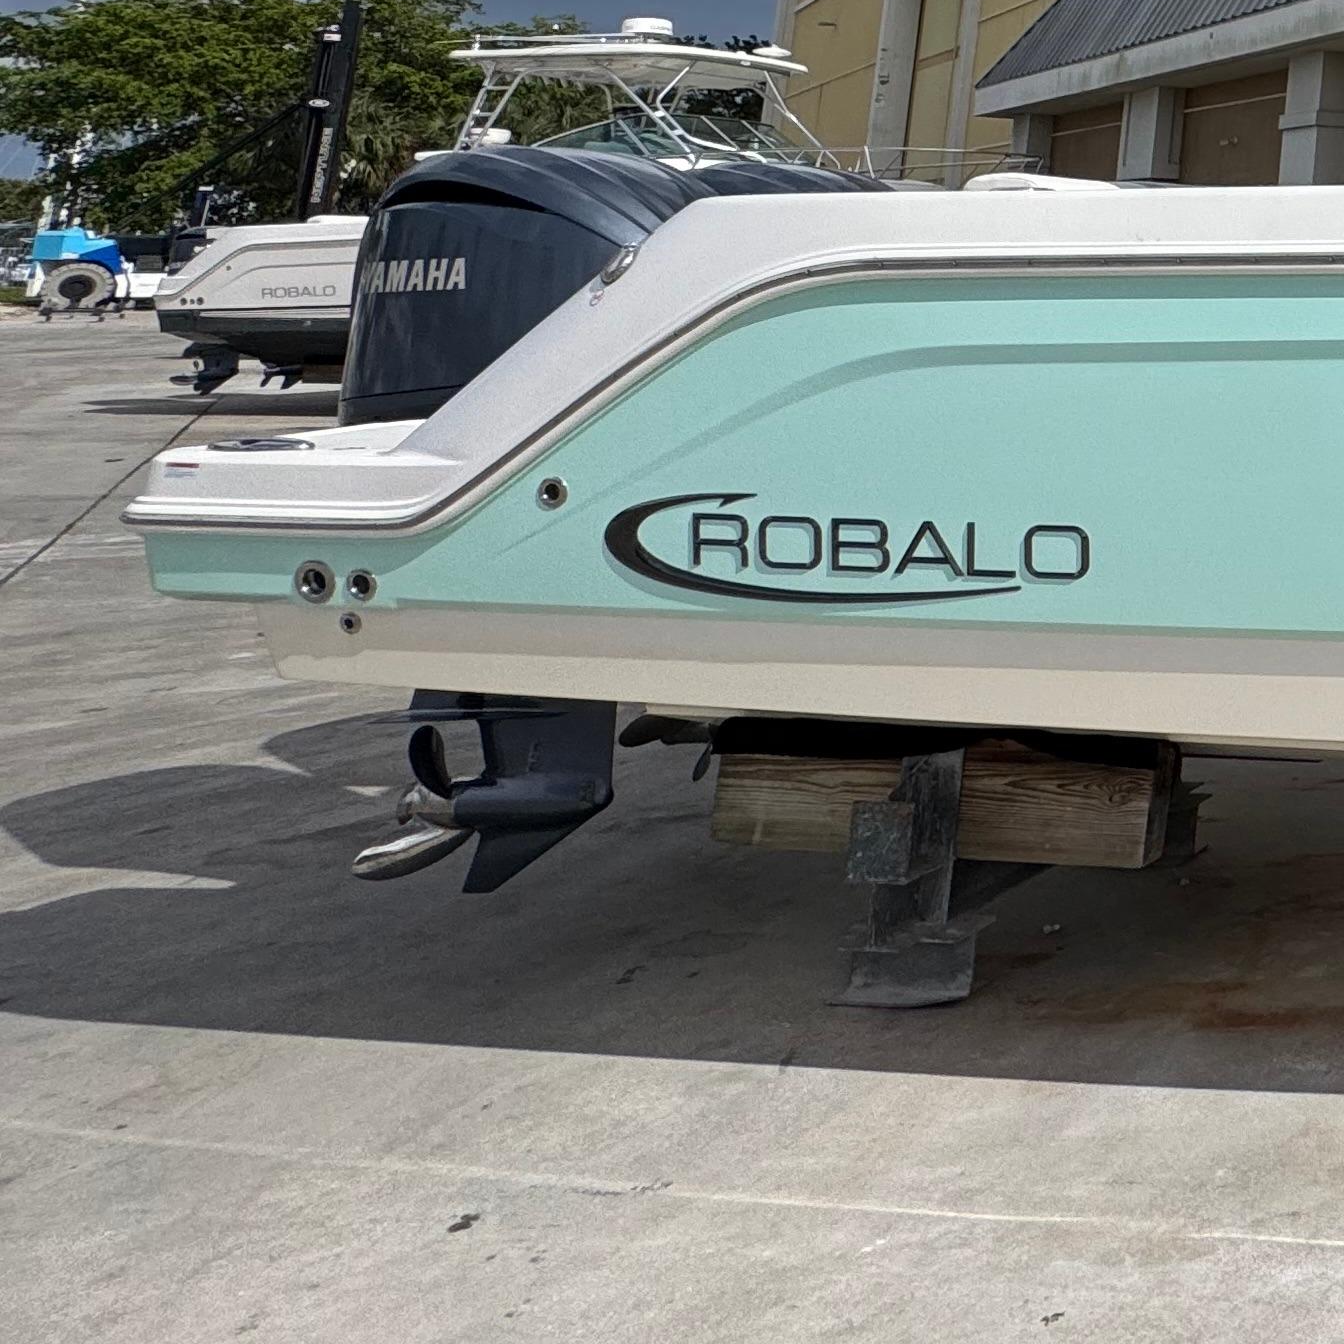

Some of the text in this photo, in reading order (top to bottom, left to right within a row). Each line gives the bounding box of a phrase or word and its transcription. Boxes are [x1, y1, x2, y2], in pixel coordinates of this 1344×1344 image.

[261, 285, 337, 299] ROBALO
[362, 258, 466, 294] YAMAHA
[692, 512, 1091, 580] ROBALO
